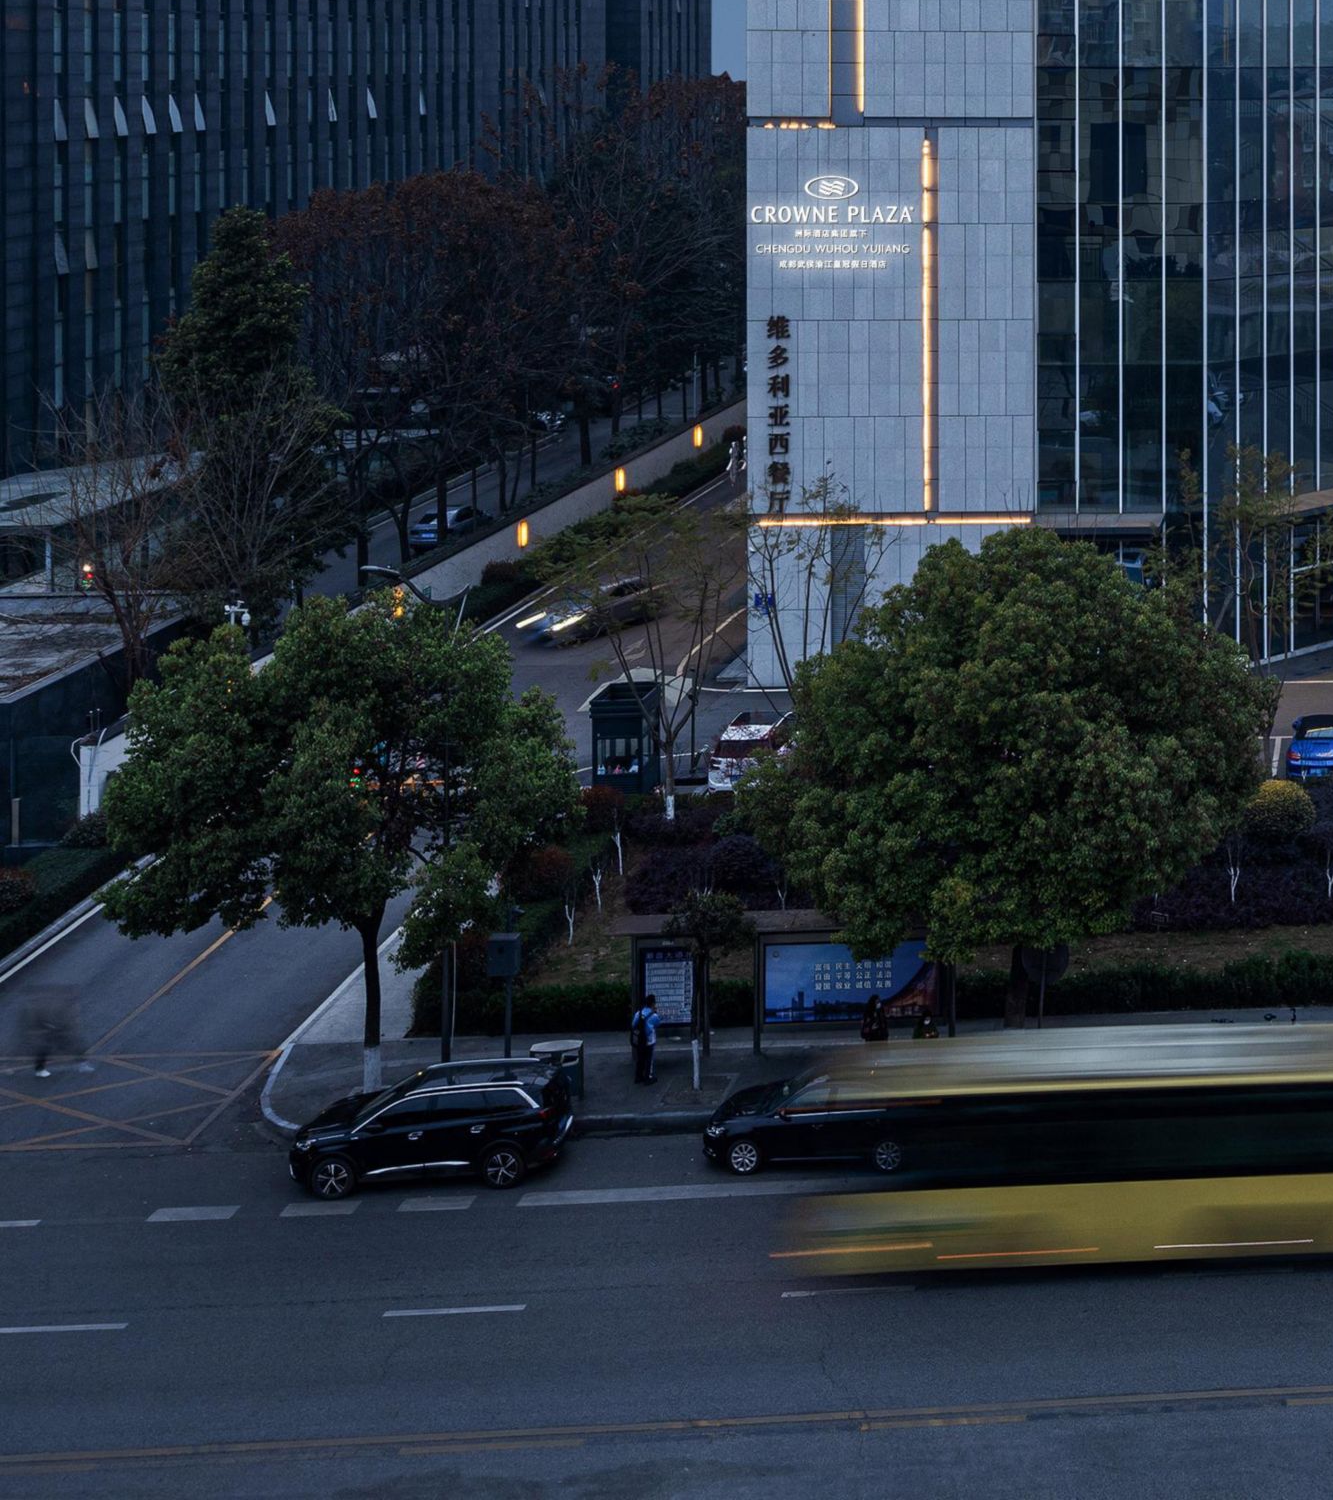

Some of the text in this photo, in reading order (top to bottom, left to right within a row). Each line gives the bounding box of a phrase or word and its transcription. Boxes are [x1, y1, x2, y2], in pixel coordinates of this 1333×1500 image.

[751, 206, 838, 223] CROWNE
[755, 244, 911, 256] CHENGDU WUHOU YUJIANG
[779, 260, 888, 269] 成都武侯渝江皇冠假日酒店
[767, 315, 790, 514] 维多利亚西餐厅
